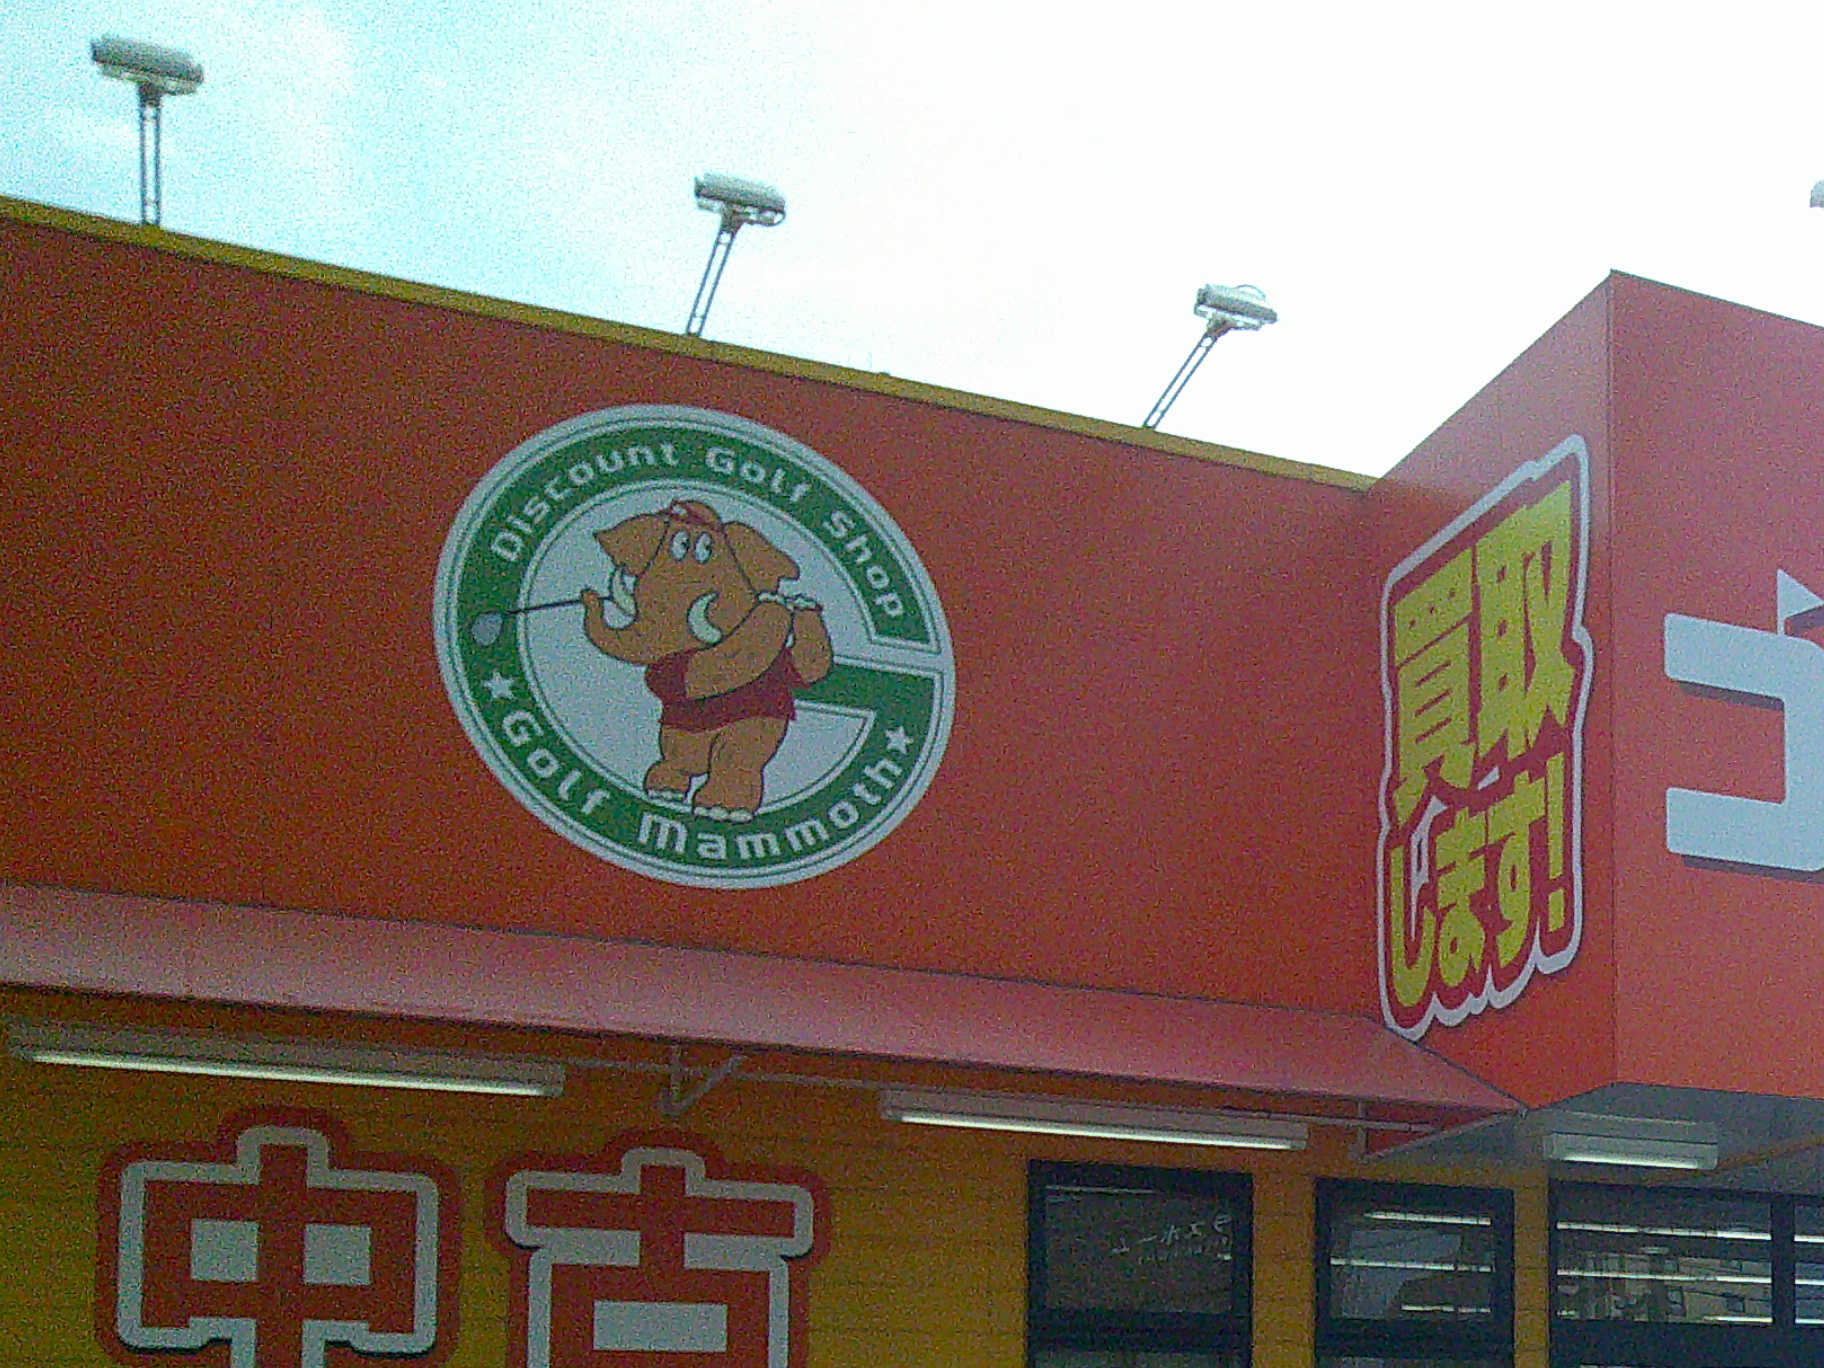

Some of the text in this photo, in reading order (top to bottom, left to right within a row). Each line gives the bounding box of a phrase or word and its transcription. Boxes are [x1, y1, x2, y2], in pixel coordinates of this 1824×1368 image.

[492, 440, 907, 620] Discount Golf Shop
[1392, 480, 1577, 831] 買取
[500, 702, 906, 862] Golf Mammoth
